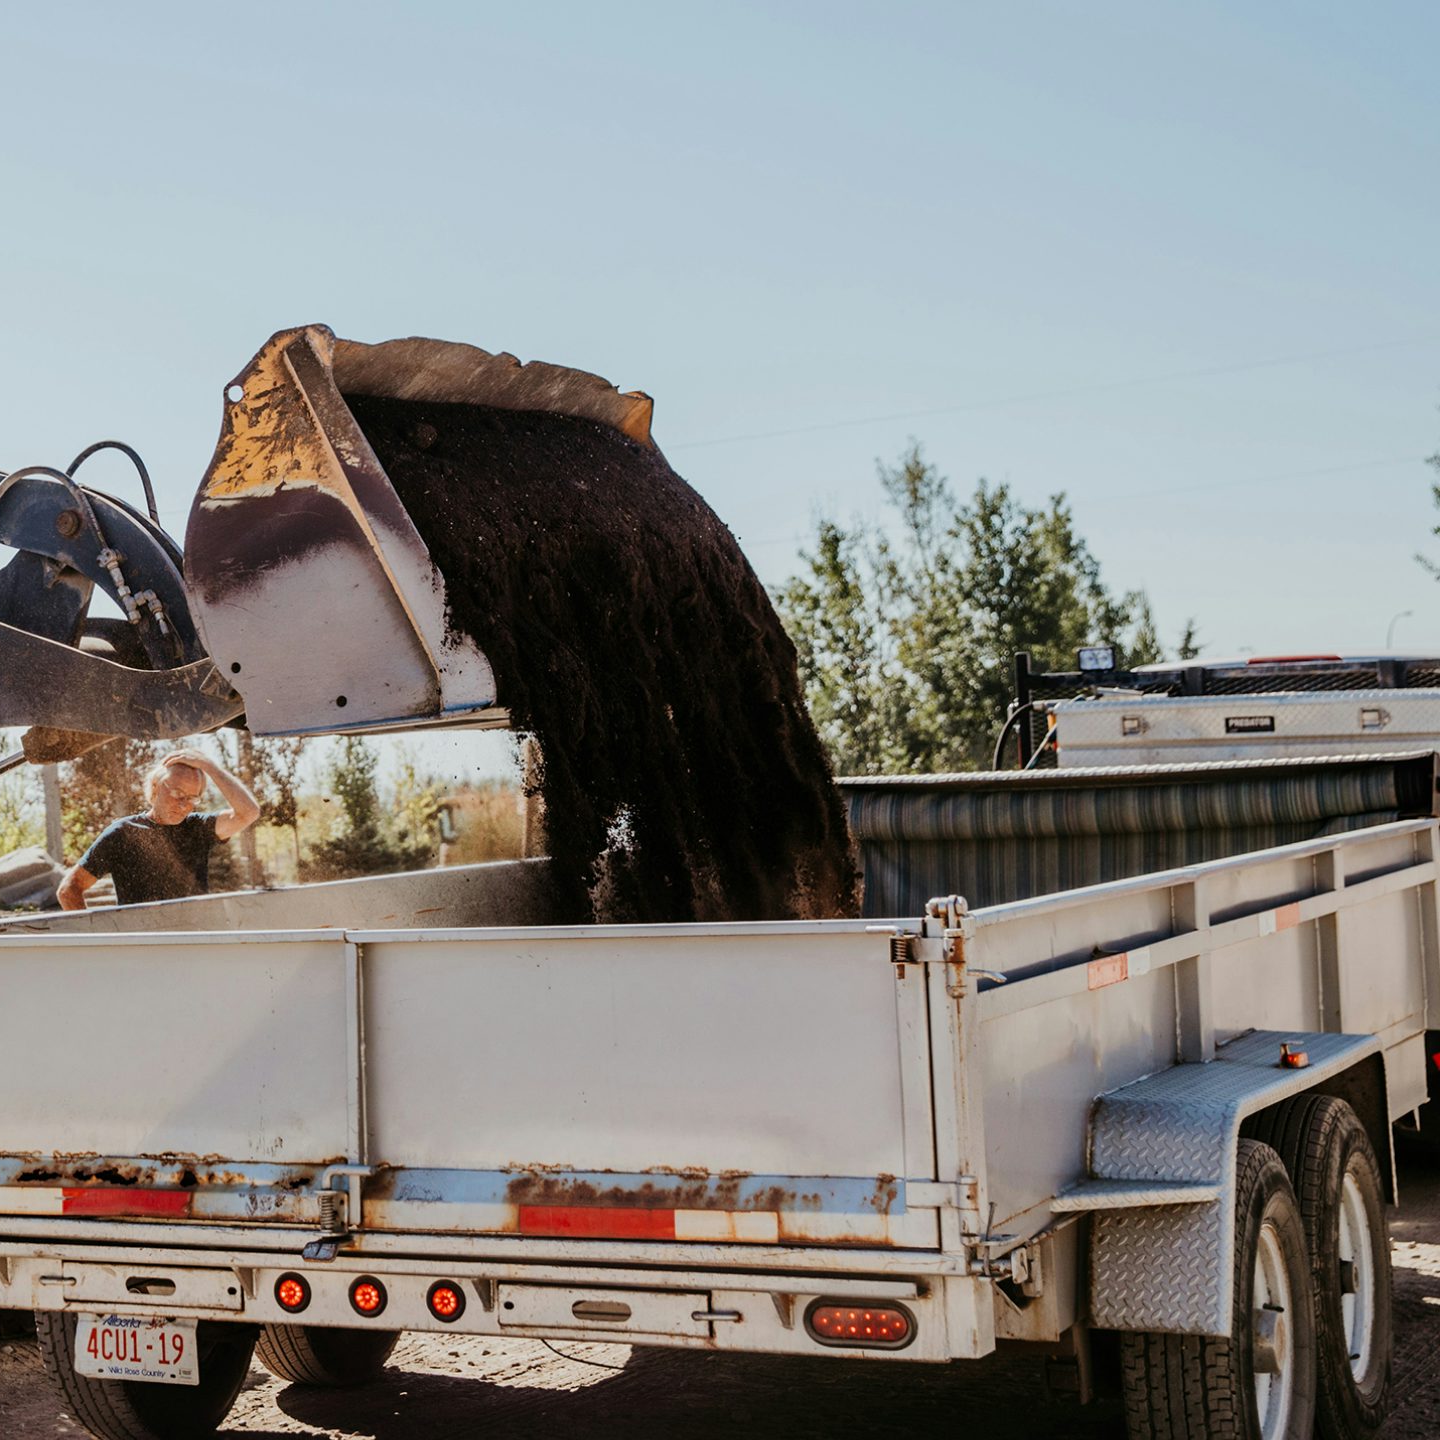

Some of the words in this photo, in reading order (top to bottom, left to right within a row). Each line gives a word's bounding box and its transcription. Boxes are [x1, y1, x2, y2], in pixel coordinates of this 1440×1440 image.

[103, 1314, 142, 1329] Alberta
[87, 1327, 184, 1365] 4CU1-19
[108, 1366, 123, 1375] Wild
[125, 1367, 140, 1376] Rose
[141, 1368, 166, 1378] Country
